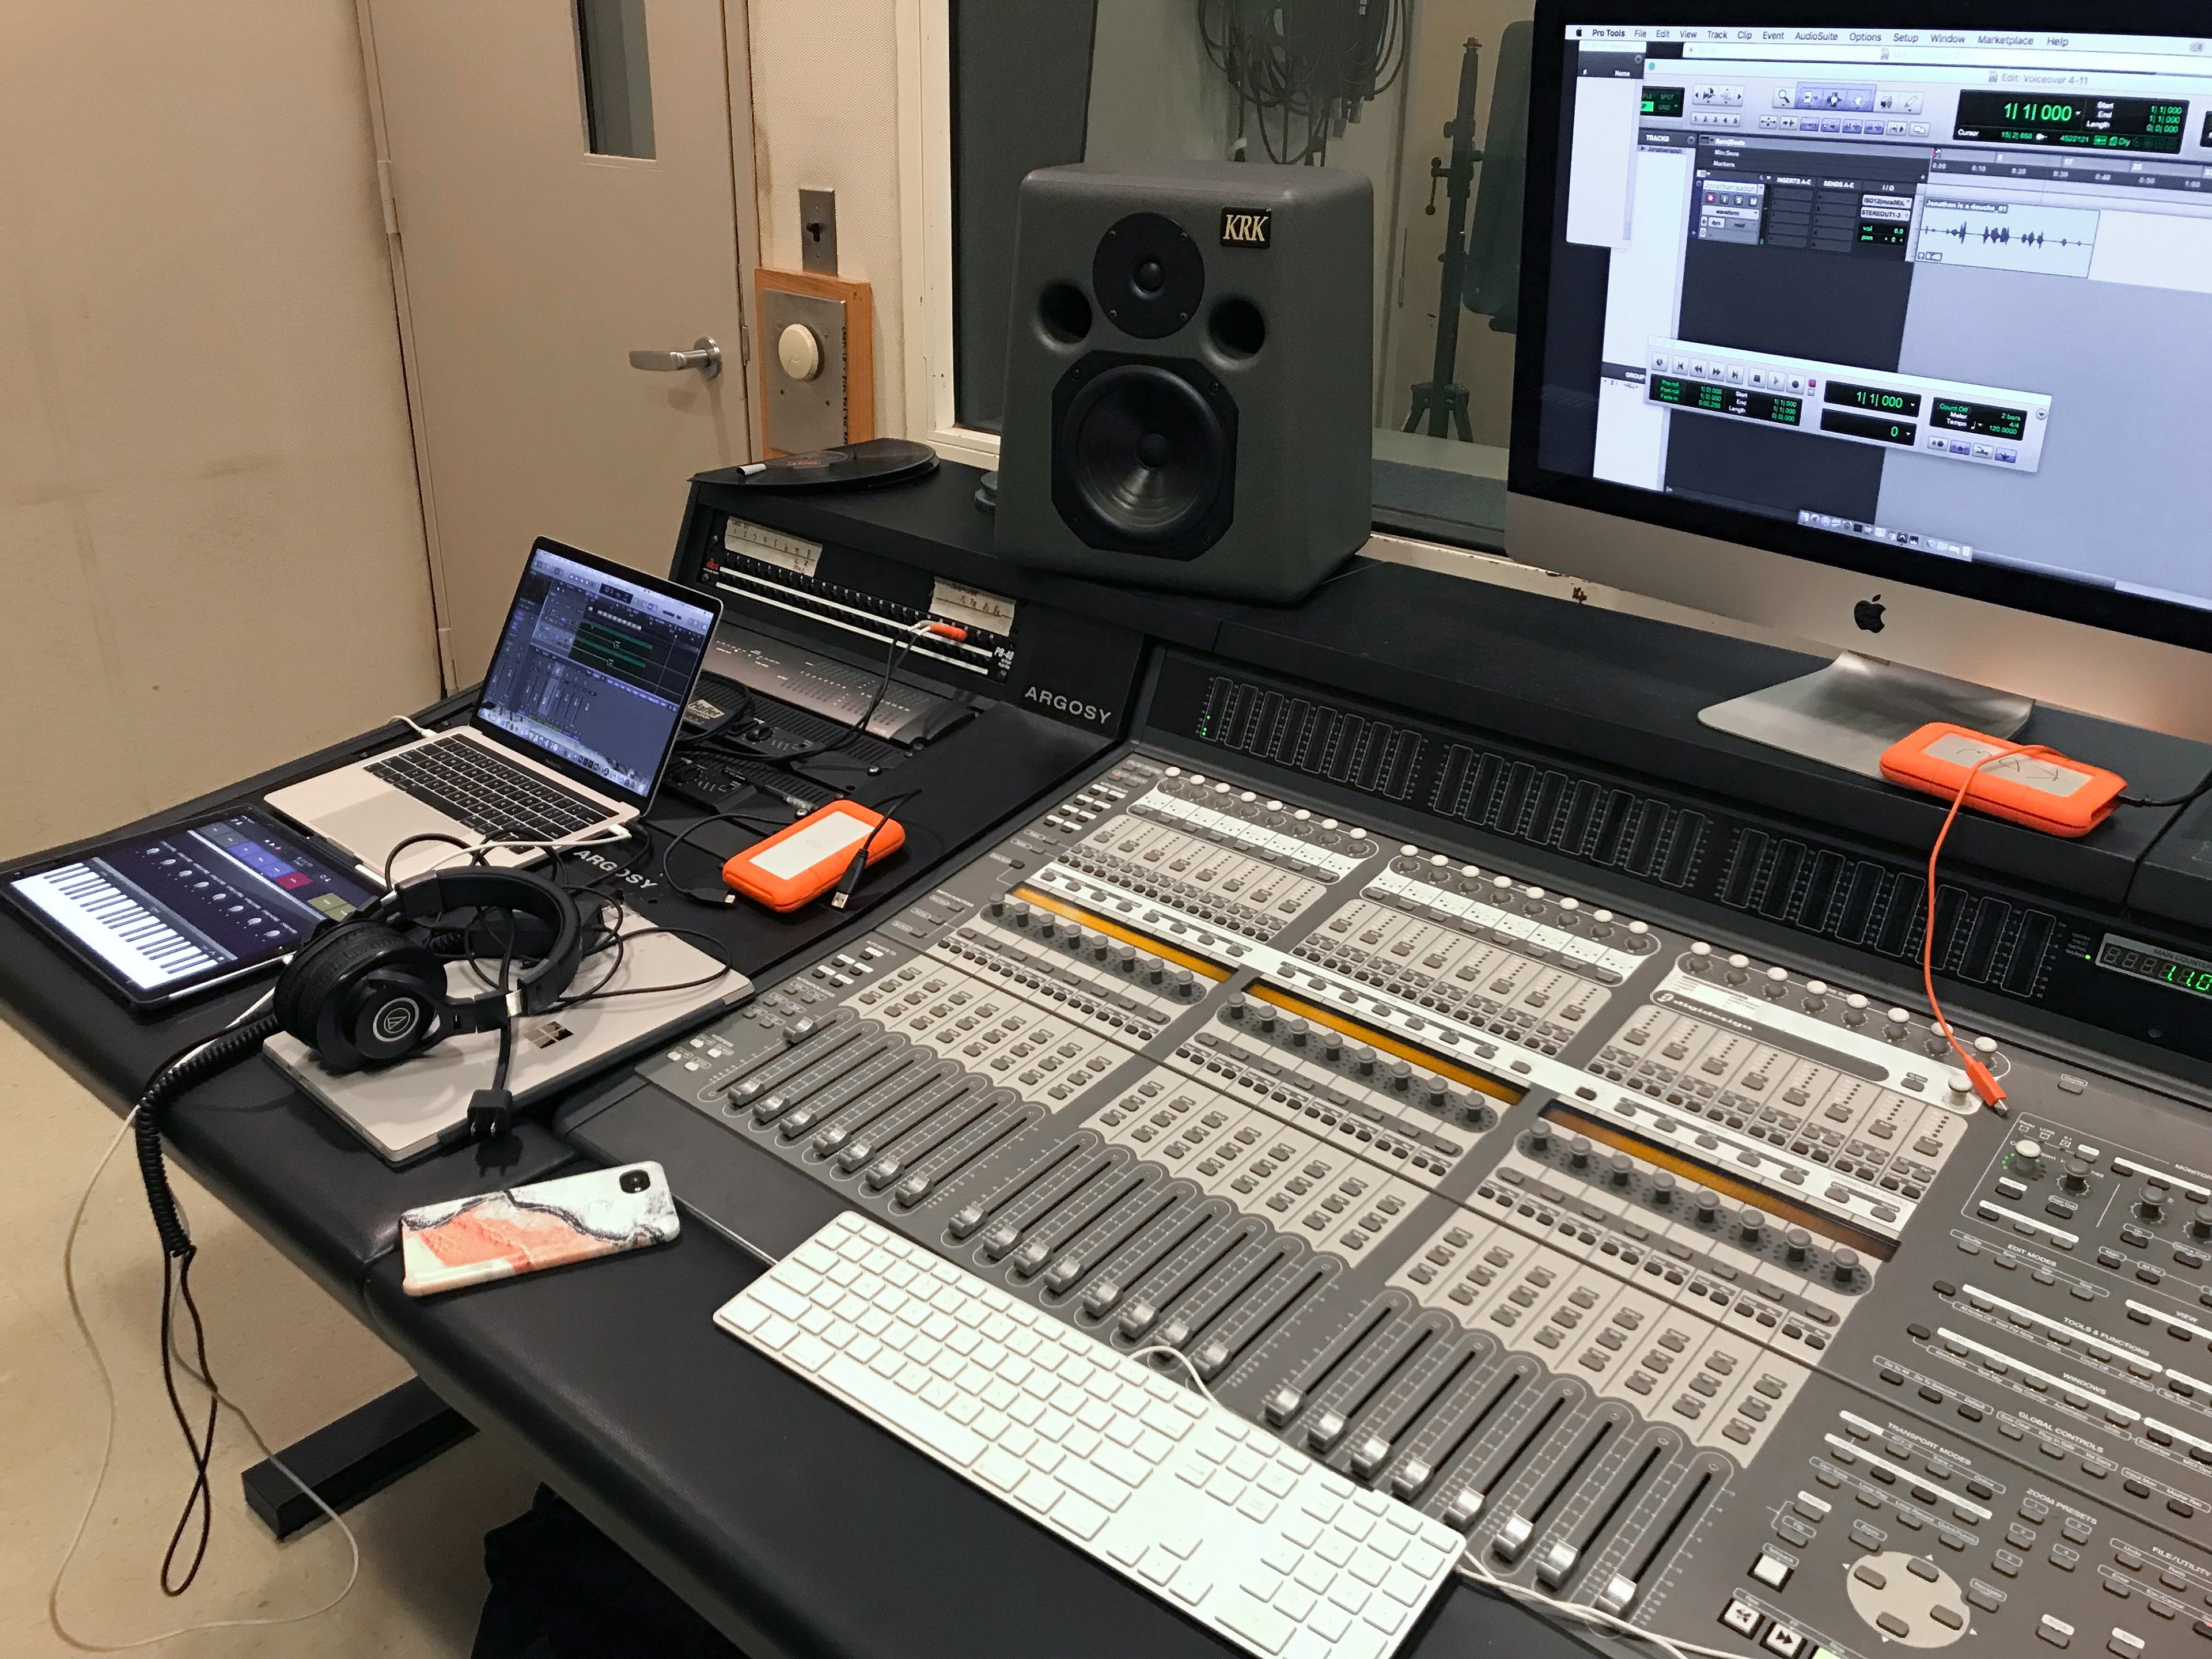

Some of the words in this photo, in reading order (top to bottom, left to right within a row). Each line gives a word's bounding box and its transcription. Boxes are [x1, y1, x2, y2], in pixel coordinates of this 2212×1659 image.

[1606, 29, 1625, 37] Tools
[1634, 29, 1647, 37] File
[1656, 30, 1670, 38] Edit
[1680, 31, 1697, 39] View
[1707, 31, 1728, 39] Track
[1737, 31, 1752, 40] Clip
[1763, 31, 1785, 40] Event
[1795, 32, 1839, 41] AudioSuite
[1849, 32, 1882, 43] Options
[1893, 33, 1919, 44] Setup
[1930, 33, 1966, 44] Window
[1978, 35, 2035, 47] Marketplace
[2047, 36, 2069, 48] Help
[2024, 74, 2066, 84] Voiceover
[2068, 77, 2089, 85] 4-11
[1646, 134, 1670, 142] TRACKS
[1957, 128, 1979, 137] Cursor
[1223, 214, 1269, 242] KRK
[706, 558, 719, 571] dbx
[1024, 686, 1112, 724] ARGOSY
[2008, 1244, 2027, 1255] EDIT
[2027, 1251, 2057, 1267] MODES
[2064, 1317, 2092, 1332] TOOLS
[2100, 1332, 2150, 1357] FUNCTIONS
[2063, 1372, 2107, 1395] WINDOWS
[2018, 1411, 2053, 1431] GLOBAL
[2055, 1427, 2104, 1453] CONTROLS
[1888, 1422, 1939, 1450] TRANSPORT
[1938, 1446, 1972, 1465] MODES
[2026, 1488, 2055, 1505] ZOOM
[2055, 1501, 2097, 1525] PRESETS
[2152, 1546, 2212, 1577] FILE/UTILITY
